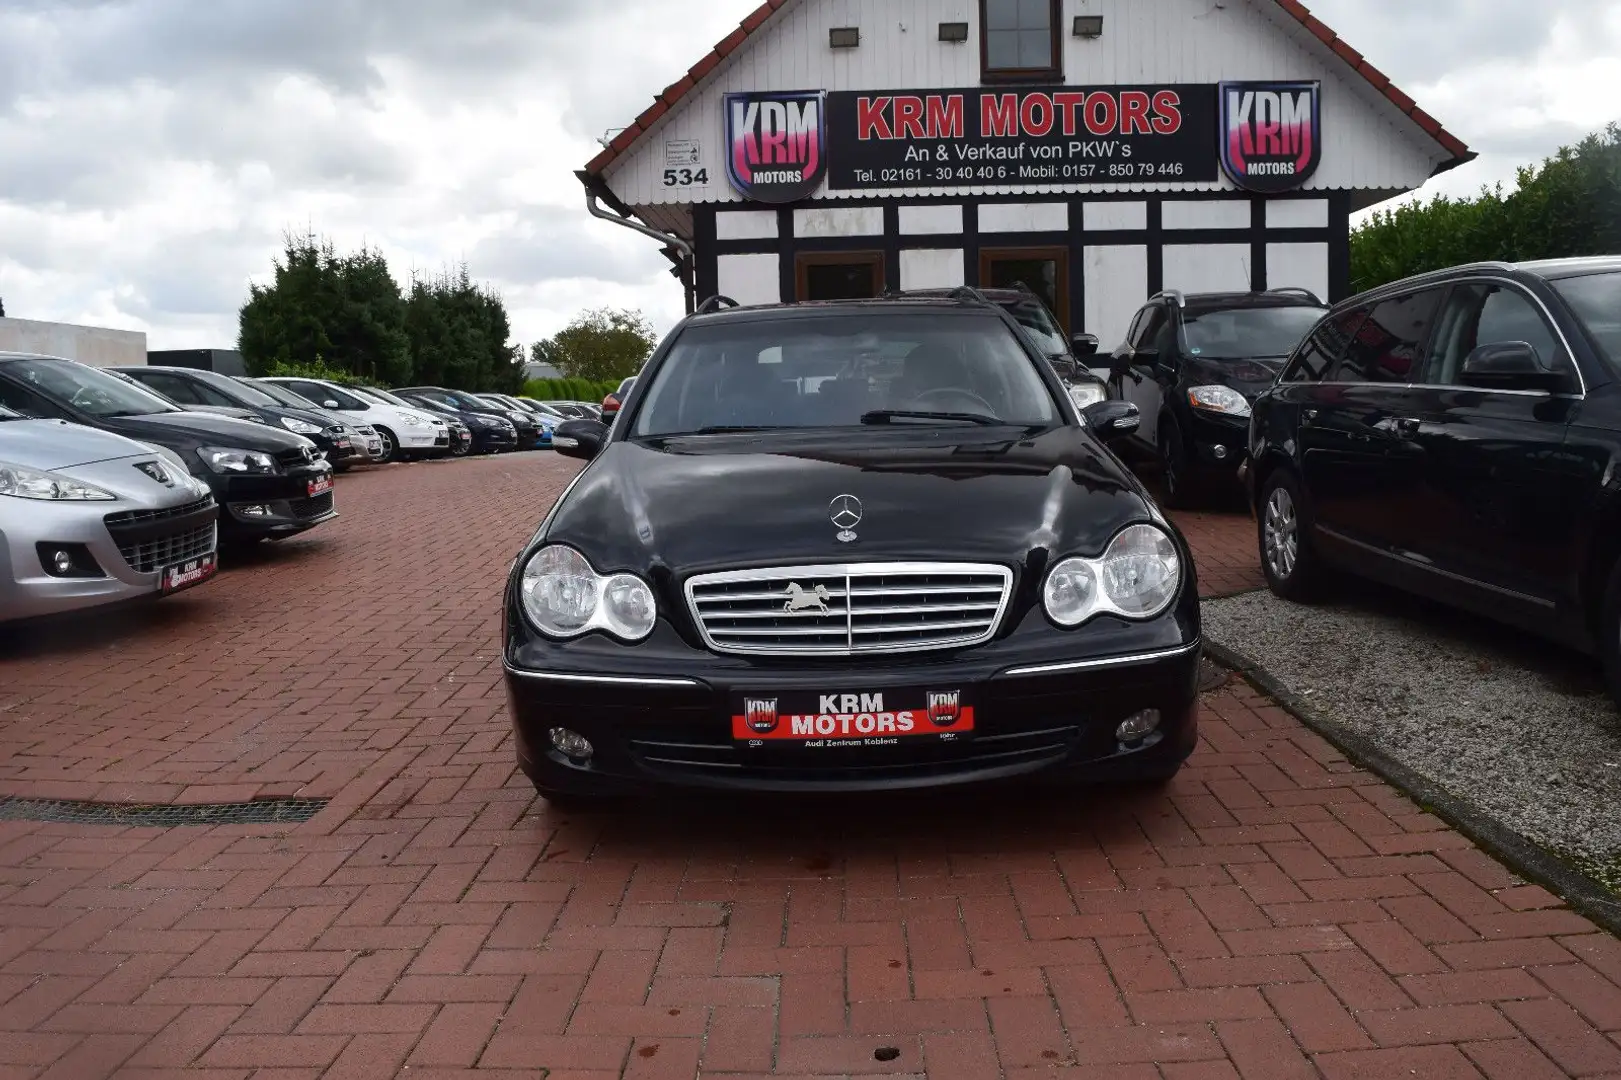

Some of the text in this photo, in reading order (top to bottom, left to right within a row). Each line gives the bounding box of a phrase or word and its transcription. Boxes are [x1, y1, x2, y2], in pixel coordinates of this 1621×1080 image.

[857, 90, 1182, 141] KRM MOTORS
[733, 101, 819, 184] KRM
[1229, 91, 1312, 176] KRM
[904, 145, 929, 162] An
[936, 145, 949, 161] &
[955, 143, 1025, 160] Verkauf
[1030, 146, 1062, 159] von
[663, 168, 709, 187] 534
[753, 170, 802, 184] MOTORS
[854, 170, 877, 182] Tel.
[881, 168, 922, 182] 02161
[935, 168, 952, 180] 30
[956, 167, 972, 179] 40
[976, 167, 993, 179] 40
[997, 166, 1006, 179] 6
[1019, 165, 1059, 178] Mobil:
[1062, 165, 1095, 177] 0157
[1109, 163, 1135, 176] 850
[1137, 163, 1154, 176] 79
[1157, 163, 1183, 175] 446
[1247, 162, 1295, 176] MOTORS
[819, 692, 884, 714] KRM
[791, 711, 914, 735] MOTORS
[804, 737, 898, 747] Audi Zentrum Koblenz
